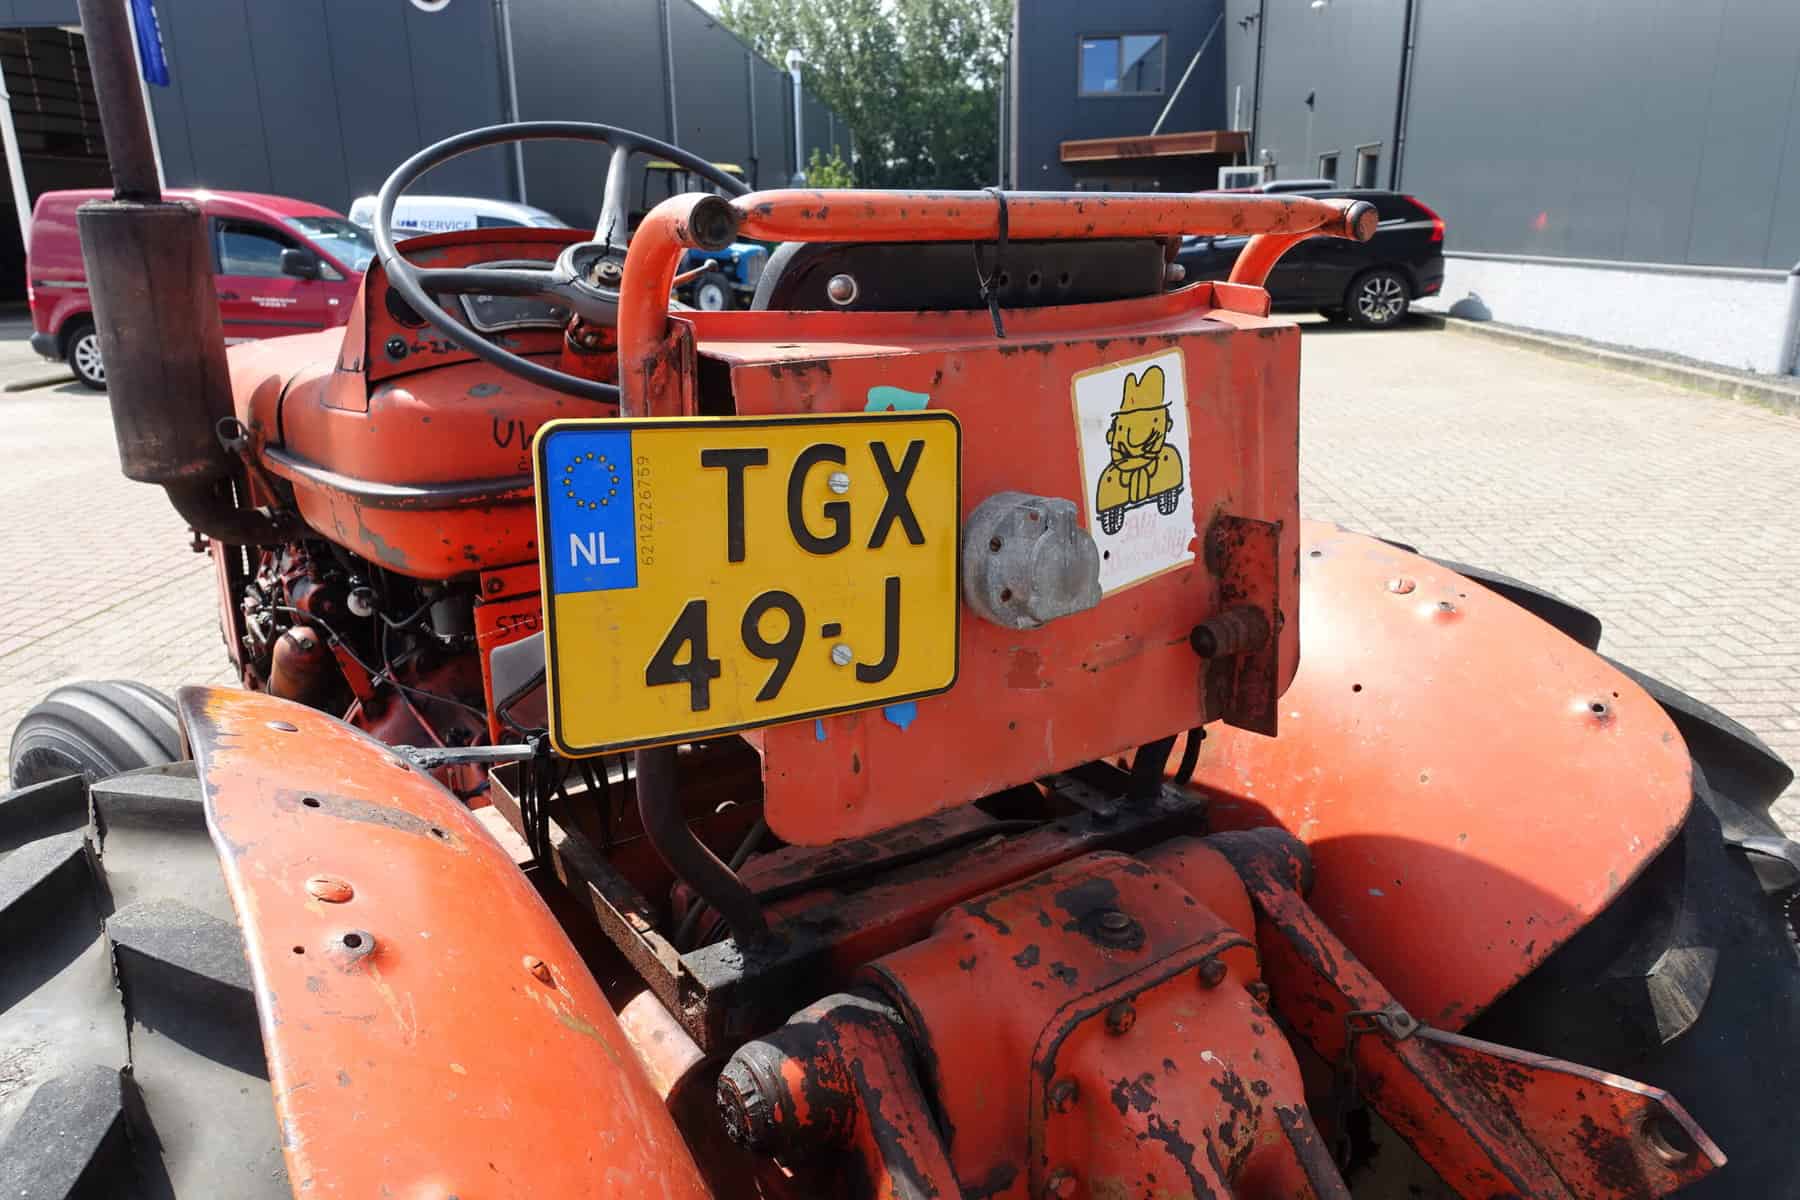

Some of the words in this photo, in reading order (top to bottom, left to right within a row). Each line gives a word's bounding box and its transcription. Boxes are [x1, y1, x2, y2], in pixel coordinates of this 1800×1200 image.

[420, 219, 472, 231] SERVICE
[701, 440, 926, 563] TGX
[569, 531, 620, 568] NL
[496, 612, 542, 640] STO
